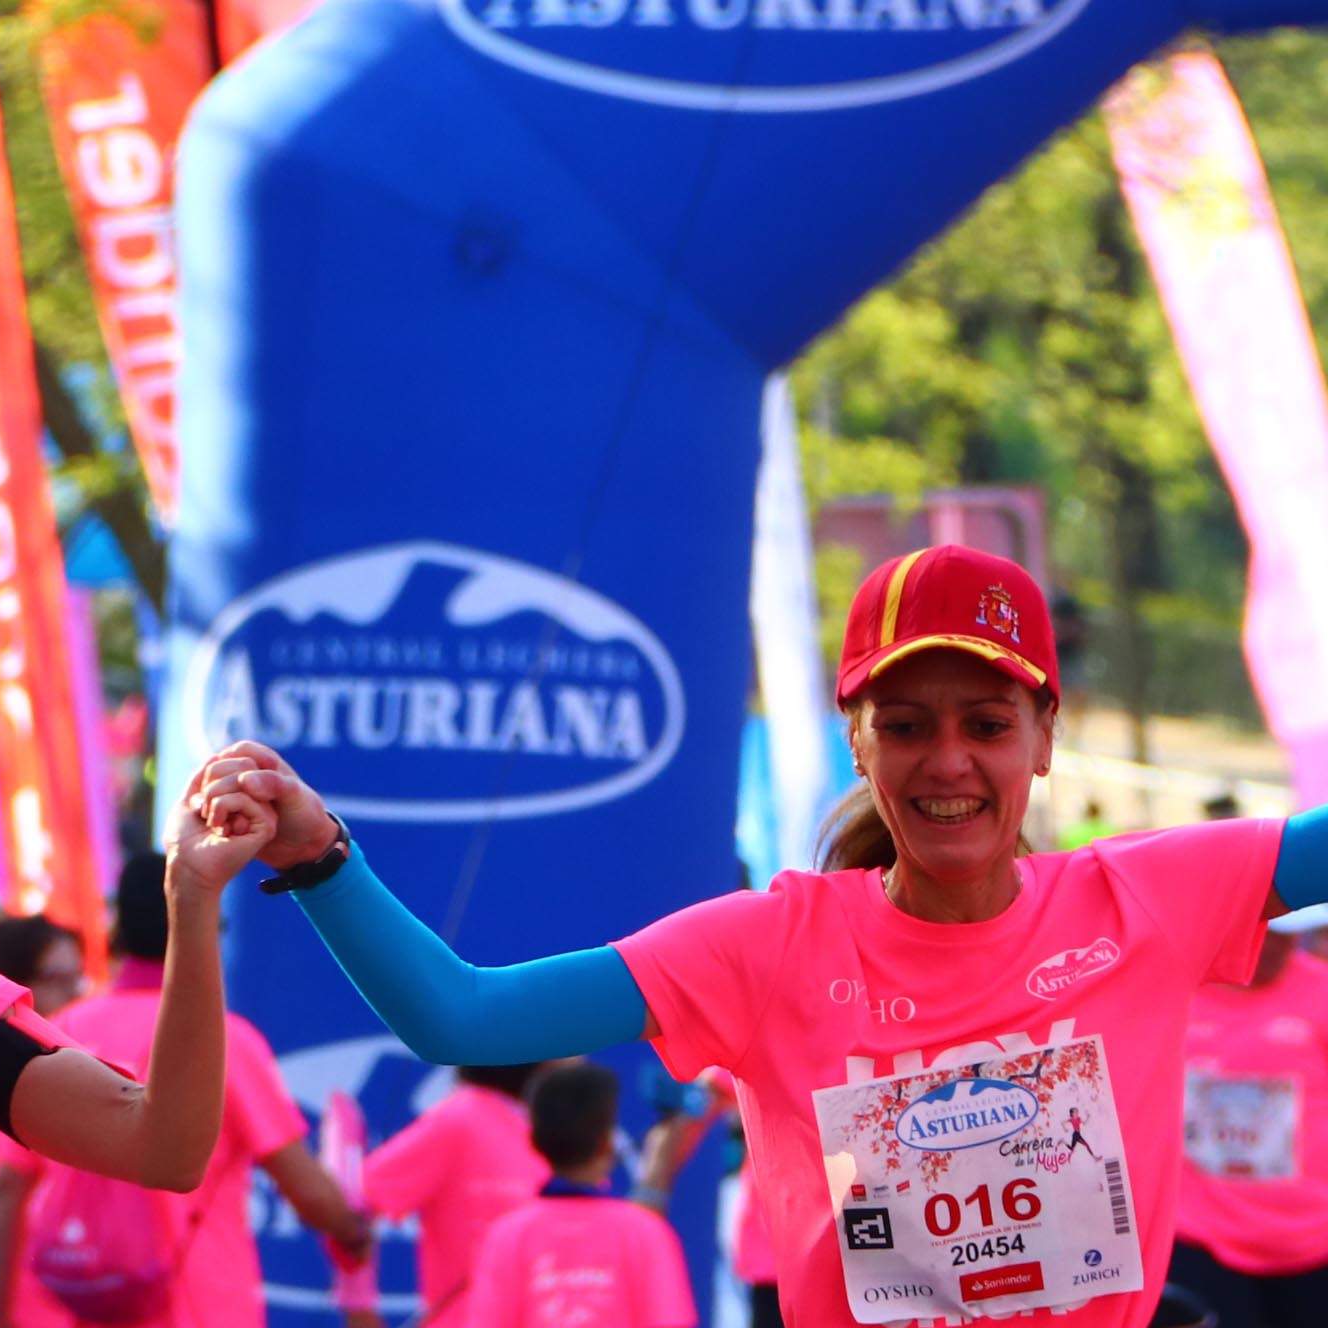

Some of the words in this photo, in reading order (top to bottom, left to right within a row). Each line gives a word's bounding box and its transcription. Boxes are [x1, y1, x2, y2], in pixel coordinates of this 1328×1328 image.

[220, 648, 654, 762] ASTURIANA
[908, 1101, 1030, 1142] ASTURIANA
[924, 1177, 1042, 1238] 016
[951, 1233, 1026, 1267] 20454
[983, 1273, 1032, 1291] Santander
[1072, 1267, 1120, 1286] ZURICH
[864, 1284, 934, 1305] OYSHO
